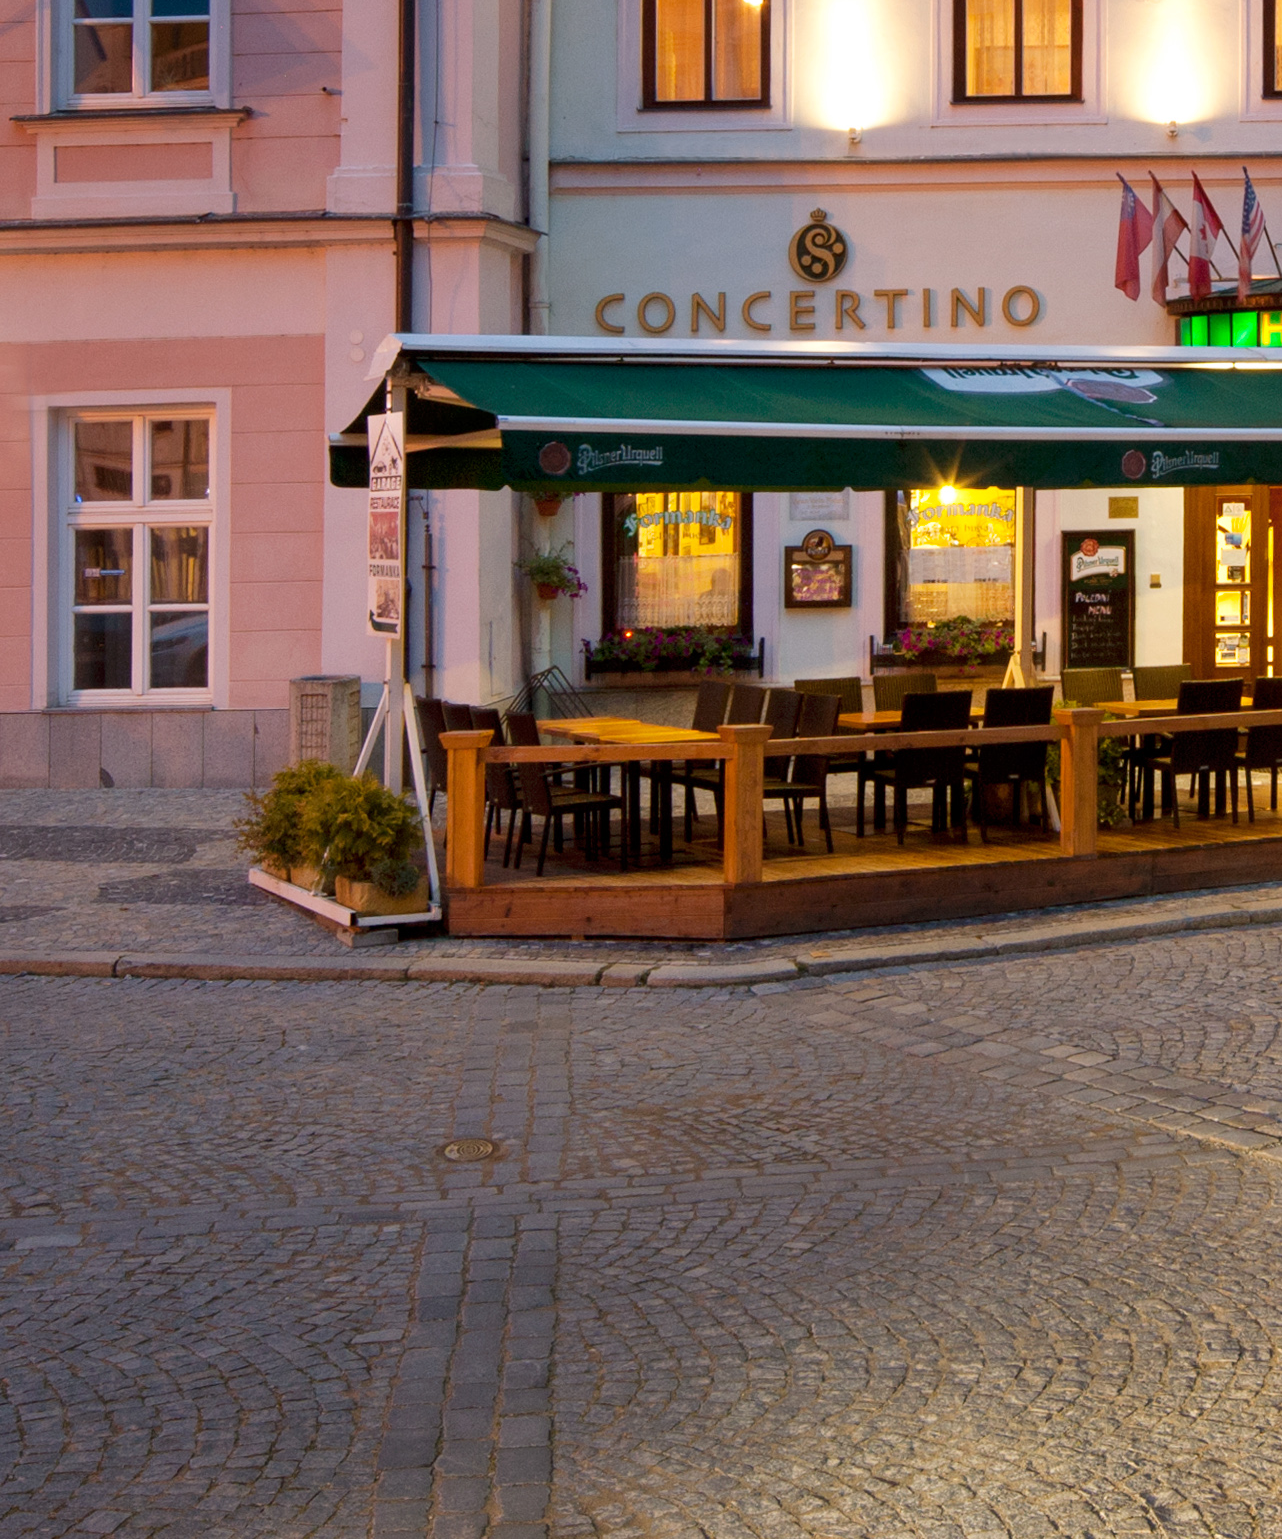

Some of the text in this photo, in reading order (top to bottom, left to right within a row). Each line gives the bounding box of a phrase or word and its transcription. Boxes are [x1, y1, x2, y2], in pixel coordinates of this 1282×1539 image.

[595, 285, 1041, 334] CONCERTINO
[578, 443, 663, 475] Pilsner Urquell
[1151, 450, 1219, 479] Pilsner Urquell
[623, 508, 732, 538] Formanka
[906, 502, 1014, 527] Formanka
[369, 564, 400, 577] FORMANKA
